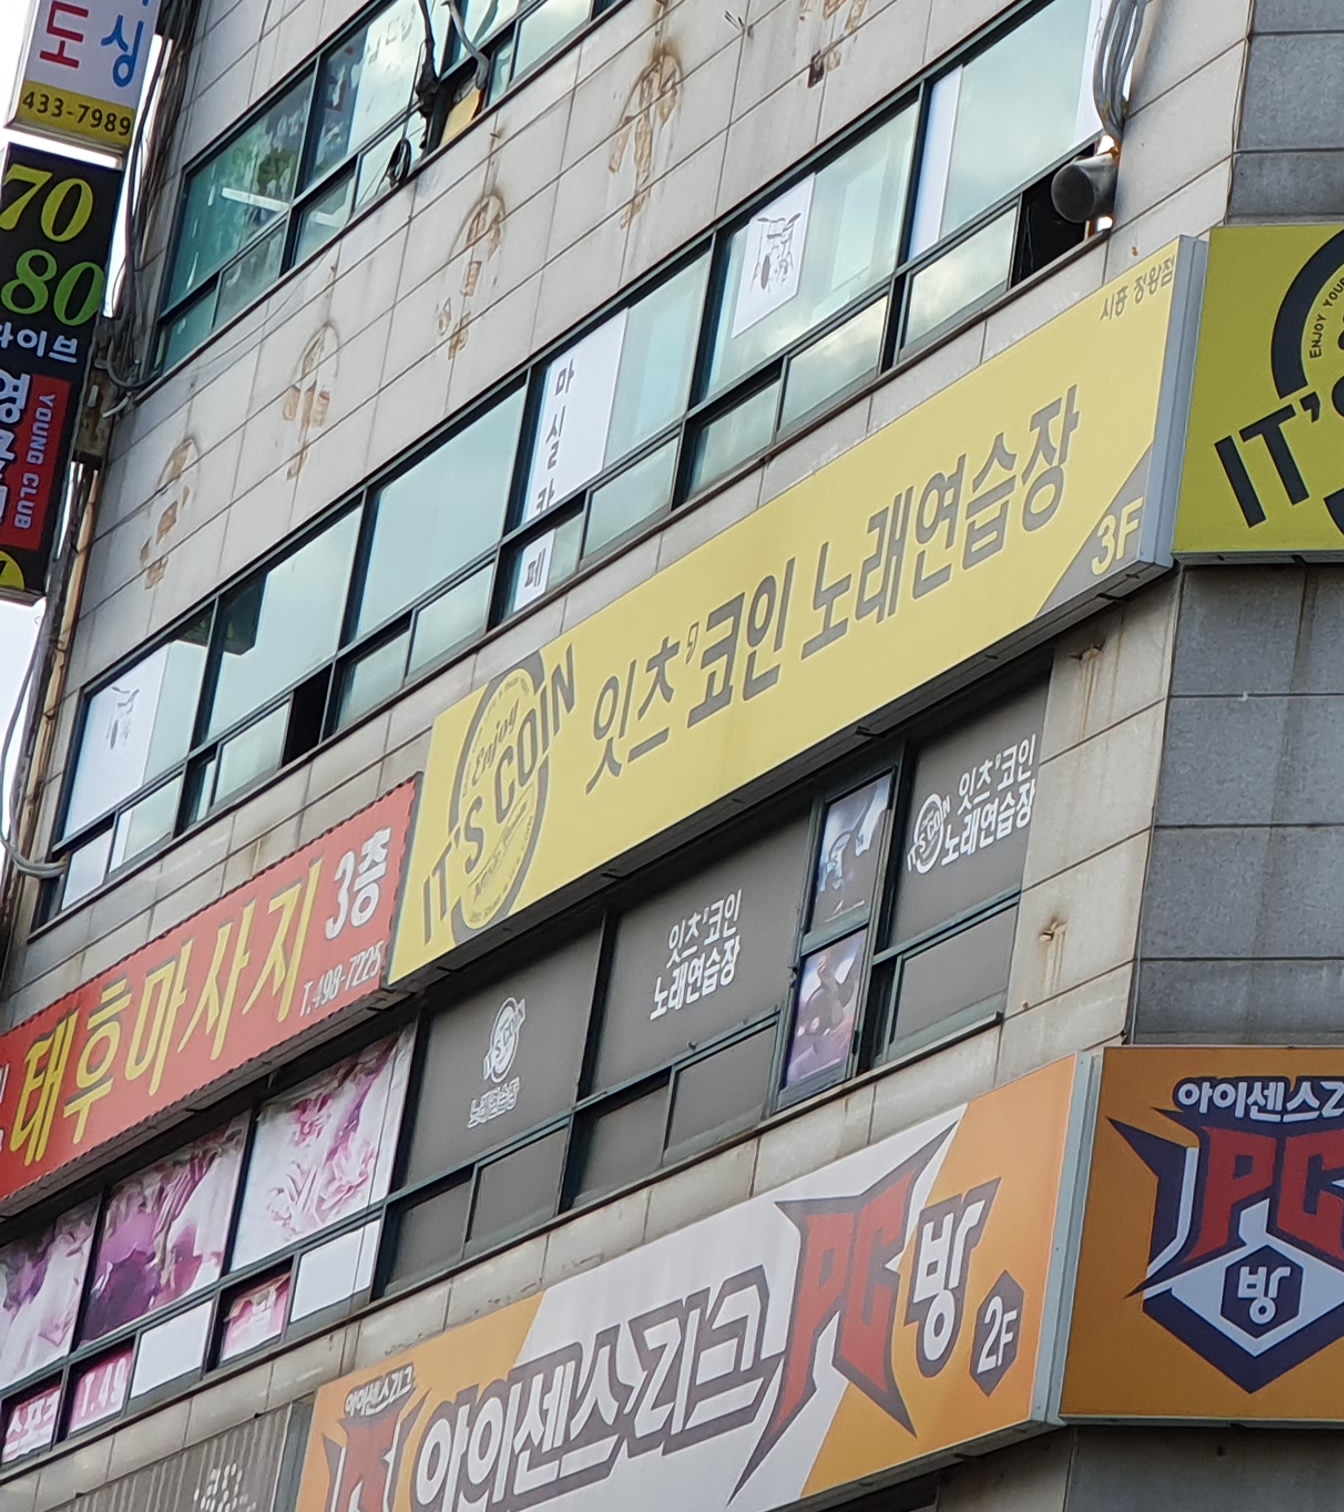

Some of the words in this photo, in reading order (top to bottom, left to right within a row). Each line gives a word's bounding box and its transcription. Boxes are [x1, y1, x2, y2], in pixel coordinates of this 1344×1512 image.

[22, 90, 132, 137] 433-7989
[0, 163, 94, 242] 70
[0, 248, 105, 326] 80
[26, 394, 55, 465] YOUNG
[14, 473, 40, 530] CLUB
[800, 384, 1080, 661] 노래연습장
[1090, 494, 1145, 577] 3F
[421, 794, 485, 947] IT'S
[493, 642, 576, 825] COIN
[941, 777, 1037, 867] 노래연습장
[325, 826, 392, 941] 3층
[9, 857, 323, 1167] 태후마사지
[650, 935, 741, 1021] 노래연습장
[979, 1306, 1019, 1371] 2F
